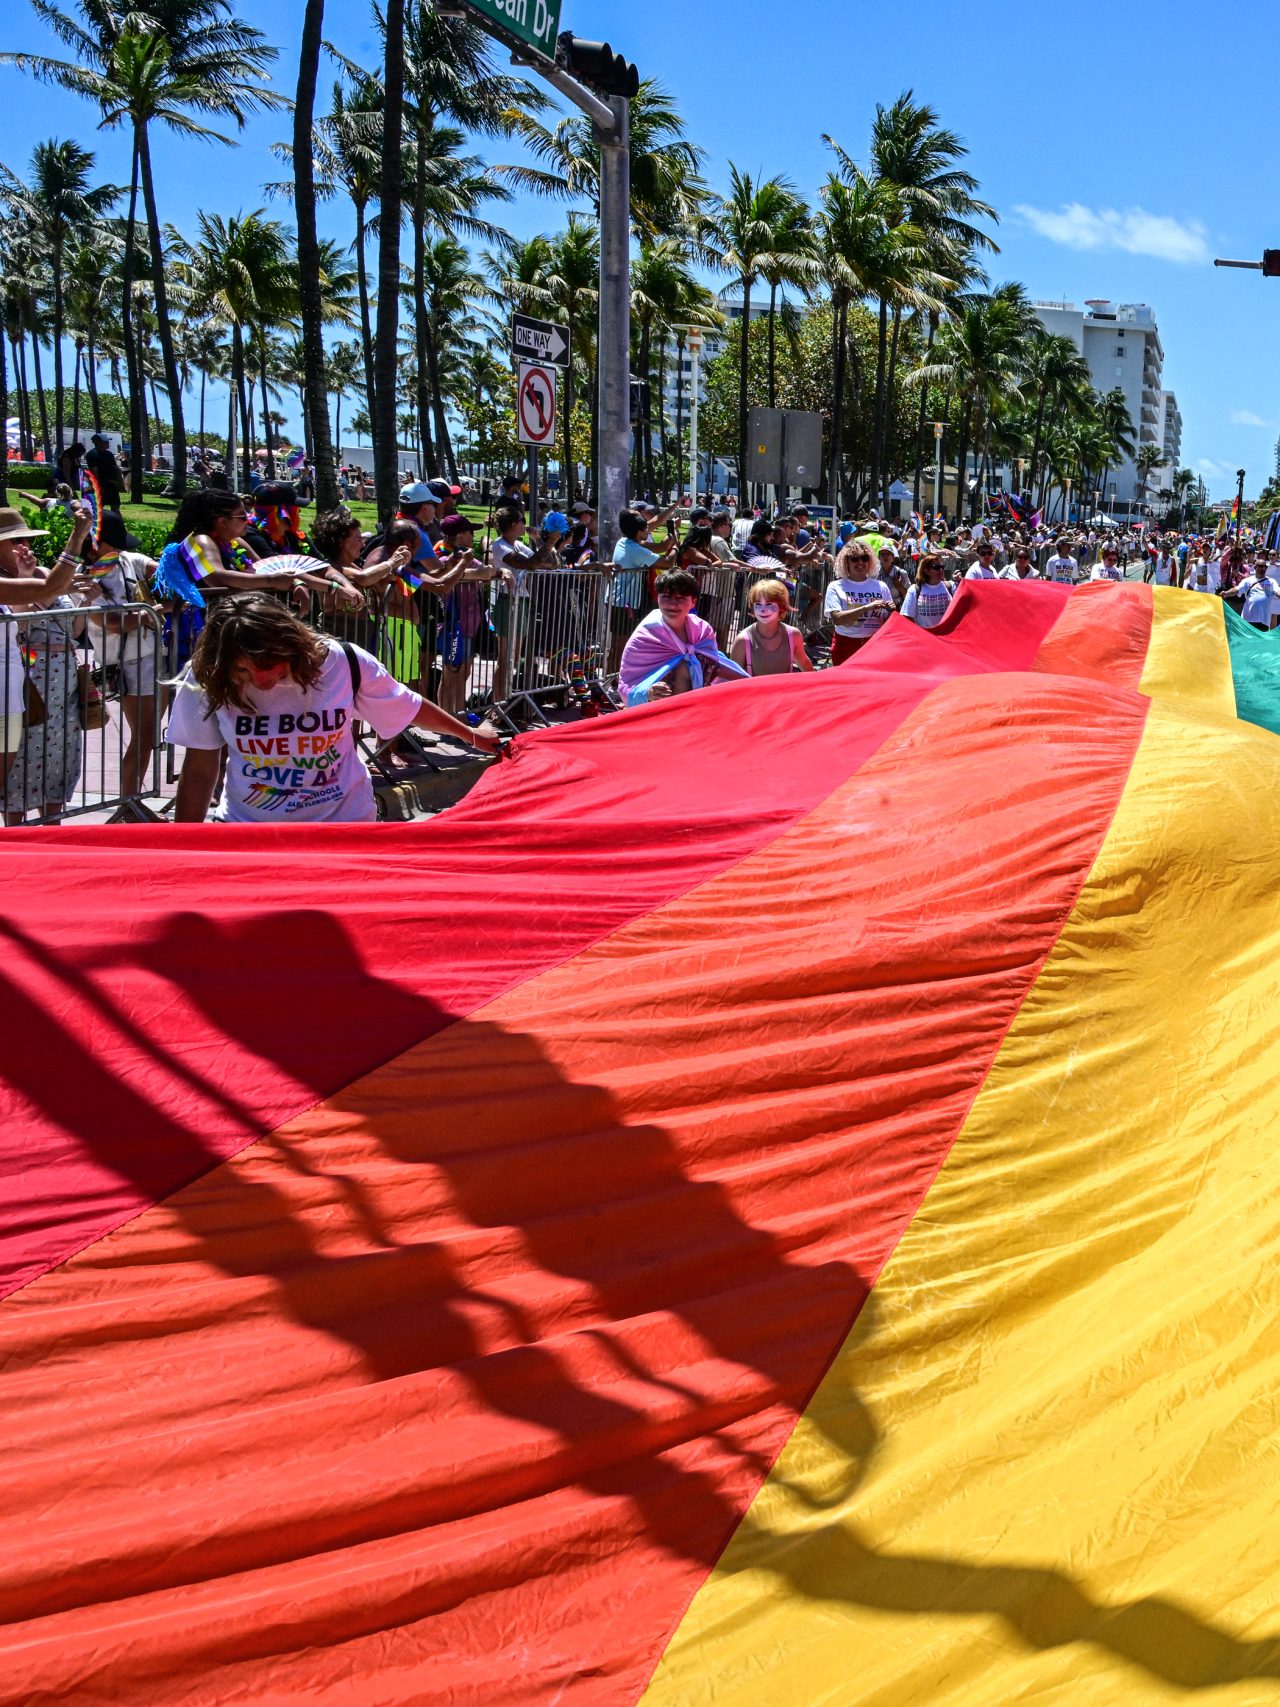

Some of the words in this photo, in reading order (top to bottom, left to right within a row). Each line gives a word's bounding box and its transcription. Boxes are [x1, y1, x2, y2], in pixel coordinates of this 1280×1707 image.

[533, 0, 554, 43] Dr
[517, 327, 532, 346] ONE
[533, 331, 551, 350] WAY
[235, 715, 270, 736] BE
[278, 708, 347, 734] BOLD
[236, 737, 290, 756] LIVE
[292, 744, 341, 770] WOKE
